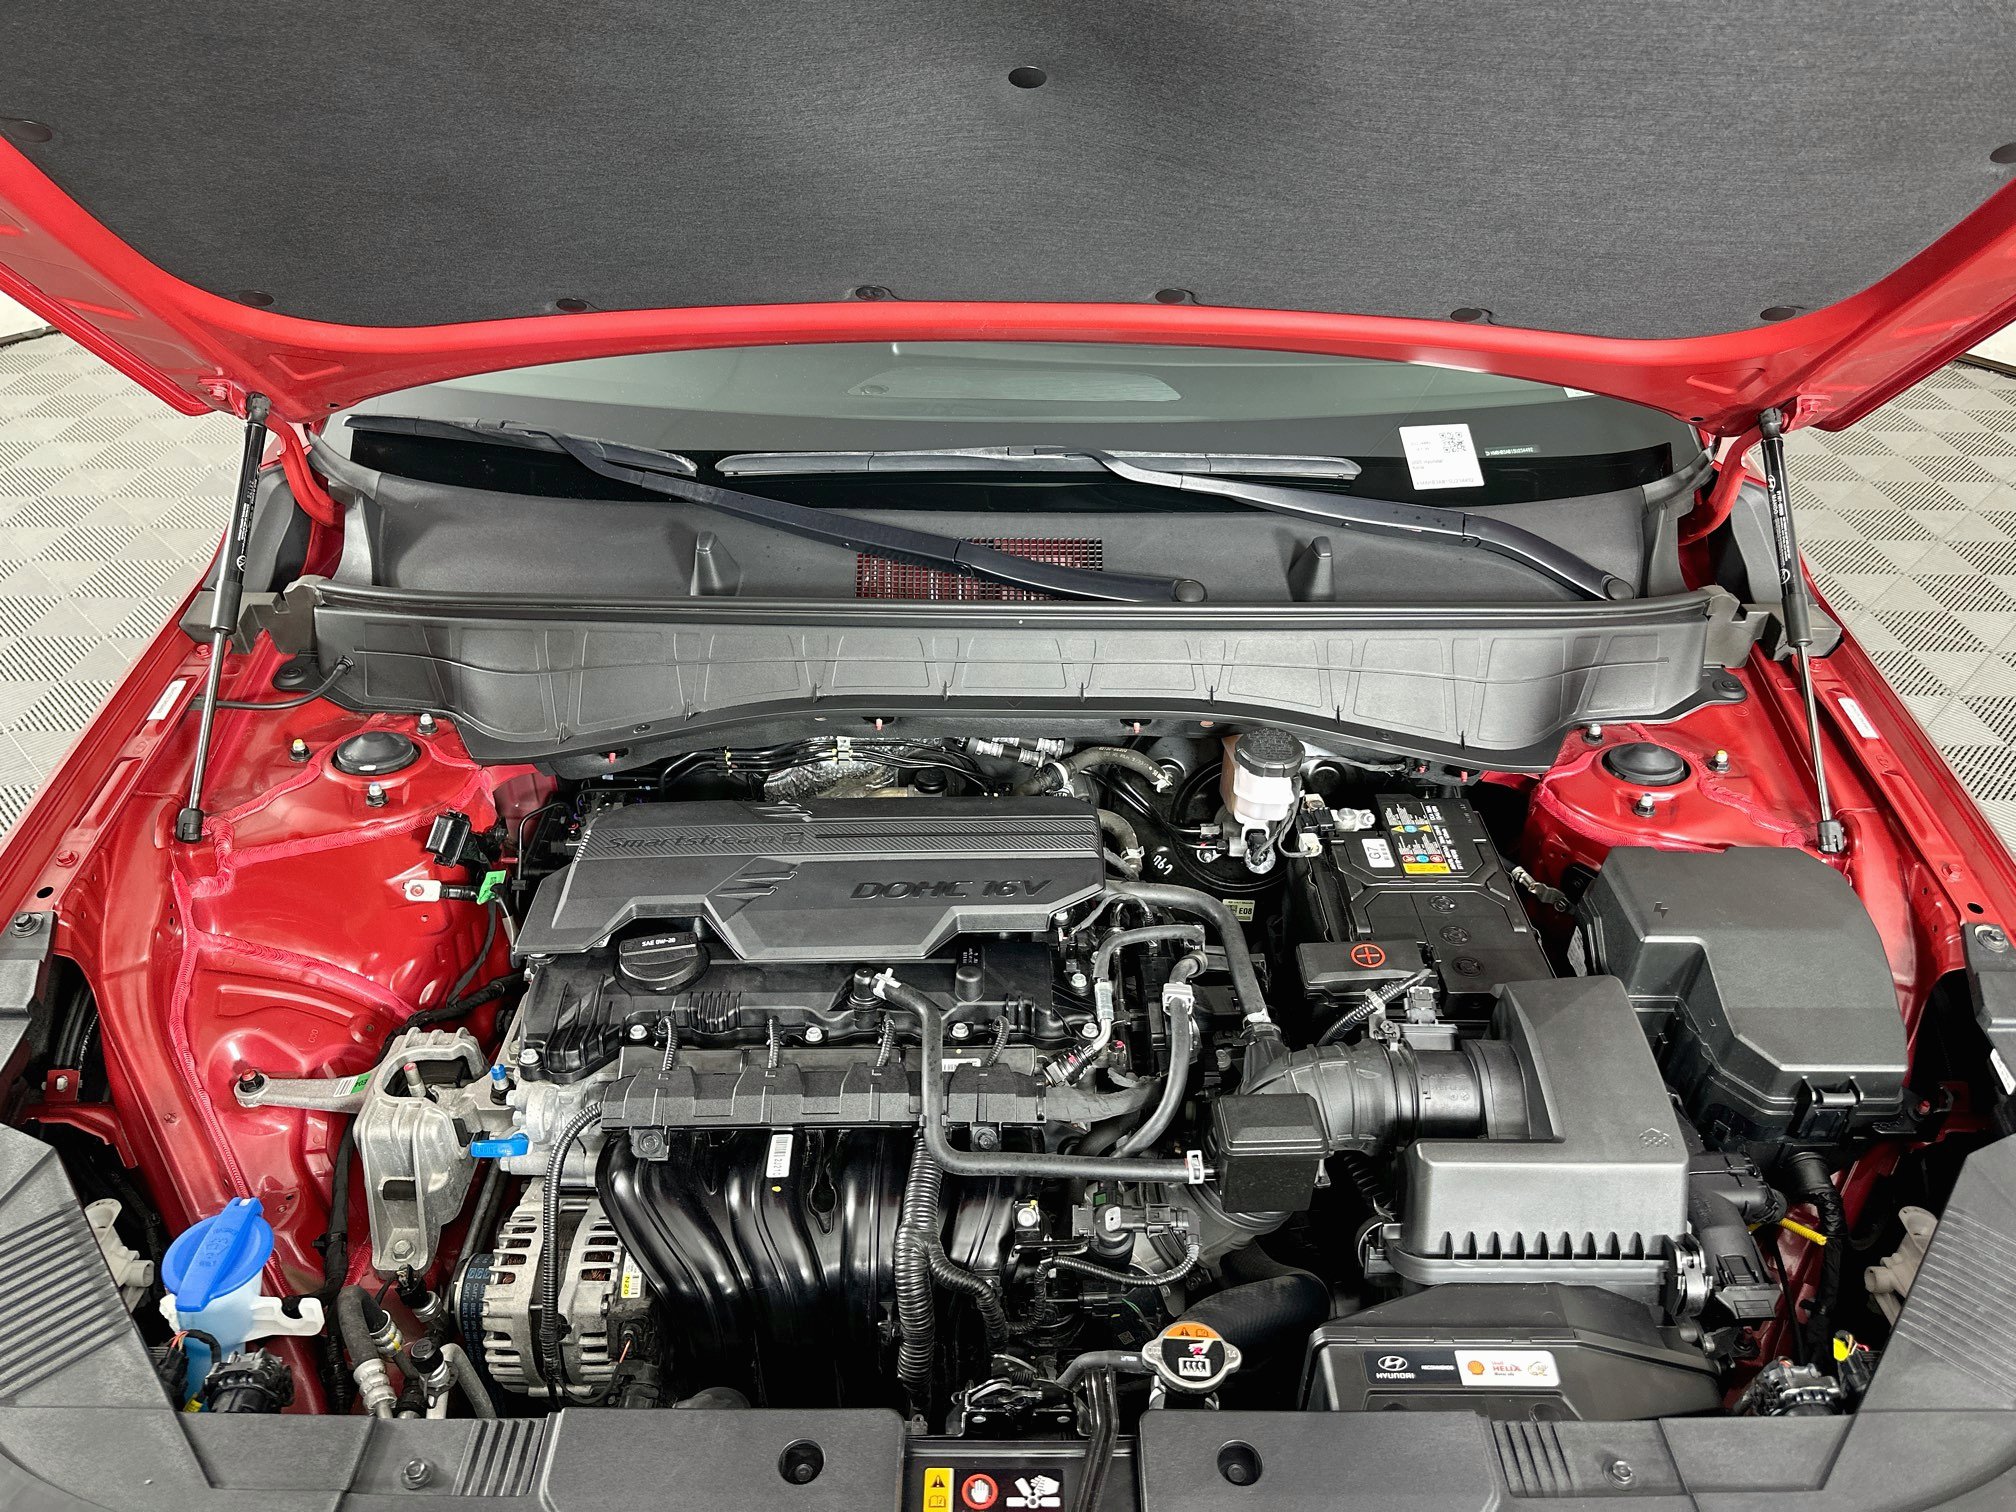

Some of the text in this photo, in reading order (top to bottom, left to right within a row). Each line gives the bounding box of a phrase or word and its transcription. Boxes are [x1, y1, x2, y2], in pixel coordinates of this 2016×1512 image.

[604, 834, 776, 849] Smartstream
[850, 879, 1053, 900] DOHC 16V
[1238, 907, 1253, 915] E08
[641, 939, 655, 947] SAE
[623, 1276, 631, 1295] N20
[1492, 1364, 1522, 1372] HELIX
[1376, 1372, 1416, 1380] HYUNDAI
